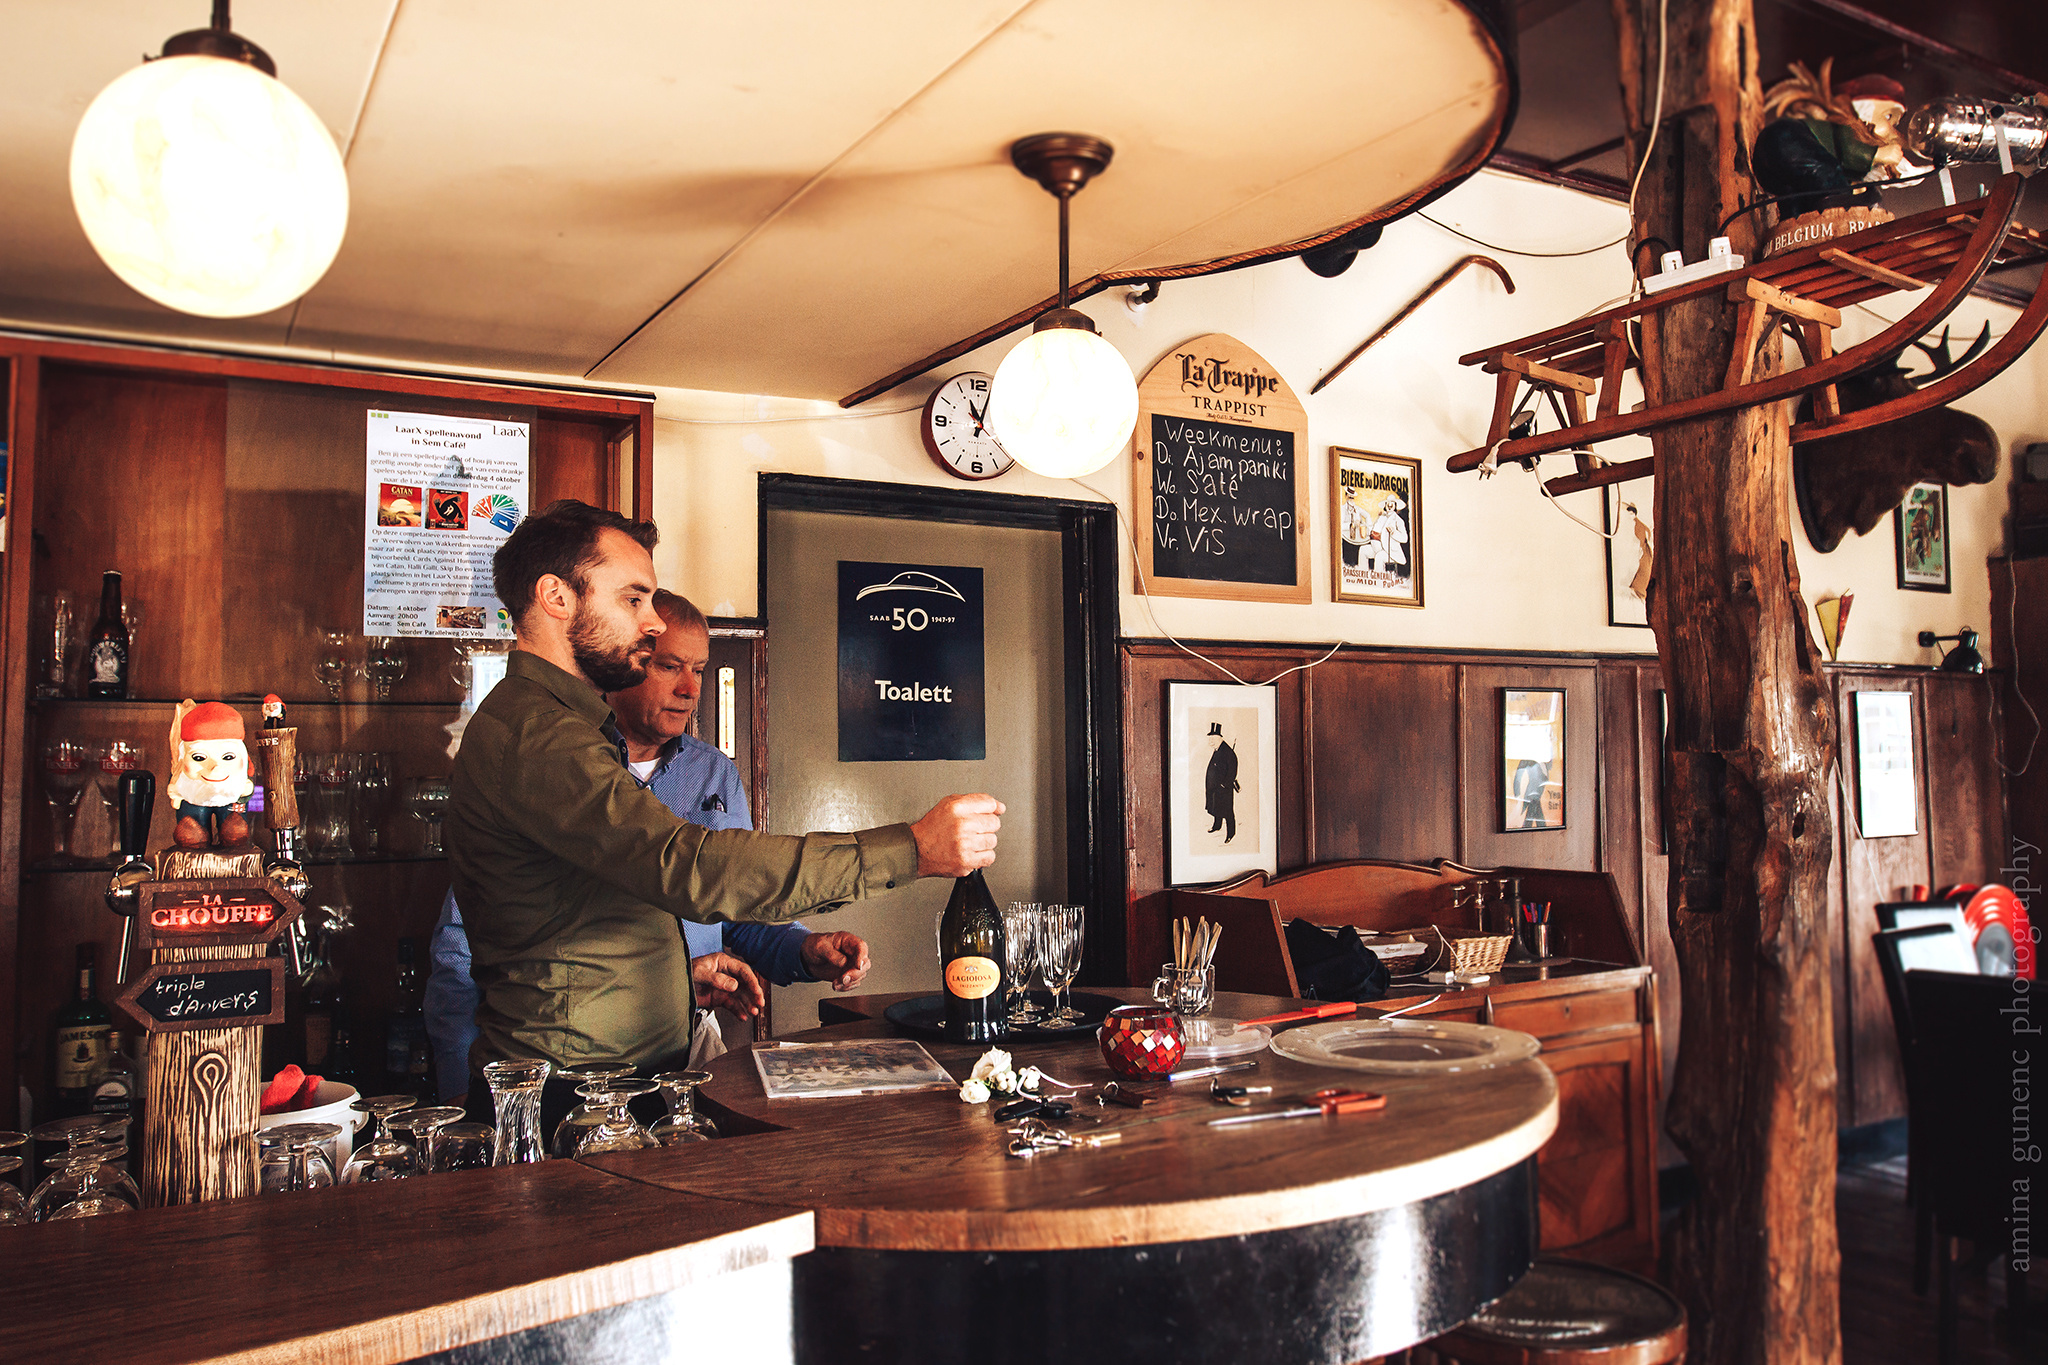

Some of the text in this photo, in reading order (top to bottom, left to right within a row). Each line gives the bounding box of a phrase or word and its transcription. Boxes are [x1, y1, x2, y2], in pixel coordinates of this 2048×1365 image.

[1775, 222, 1834, 251] BELGIUM
[970, 378, 988, 392] 12
[1175, 354, 1279, 398] La Trappe
[1192, 396, 1266, 416] TRAPPIST
[935, 415, 947, 427] 9
[395, 426, 482, 440] LaarX spellenavond
[493, 425, 526, 438] LaarX
[971, 462, 983, 473] 6
[391, 486, 413, 495] CATAN
[1373, 471, 1409, 493] DRAGON
[892, 607, 929, 631] 50
[874, 680, 953, 703] Toalett
[202, 894, 222, 906] LA
[151, 904, 274, 927] CHOUFFE
[156, 974, 205, 998] triple
